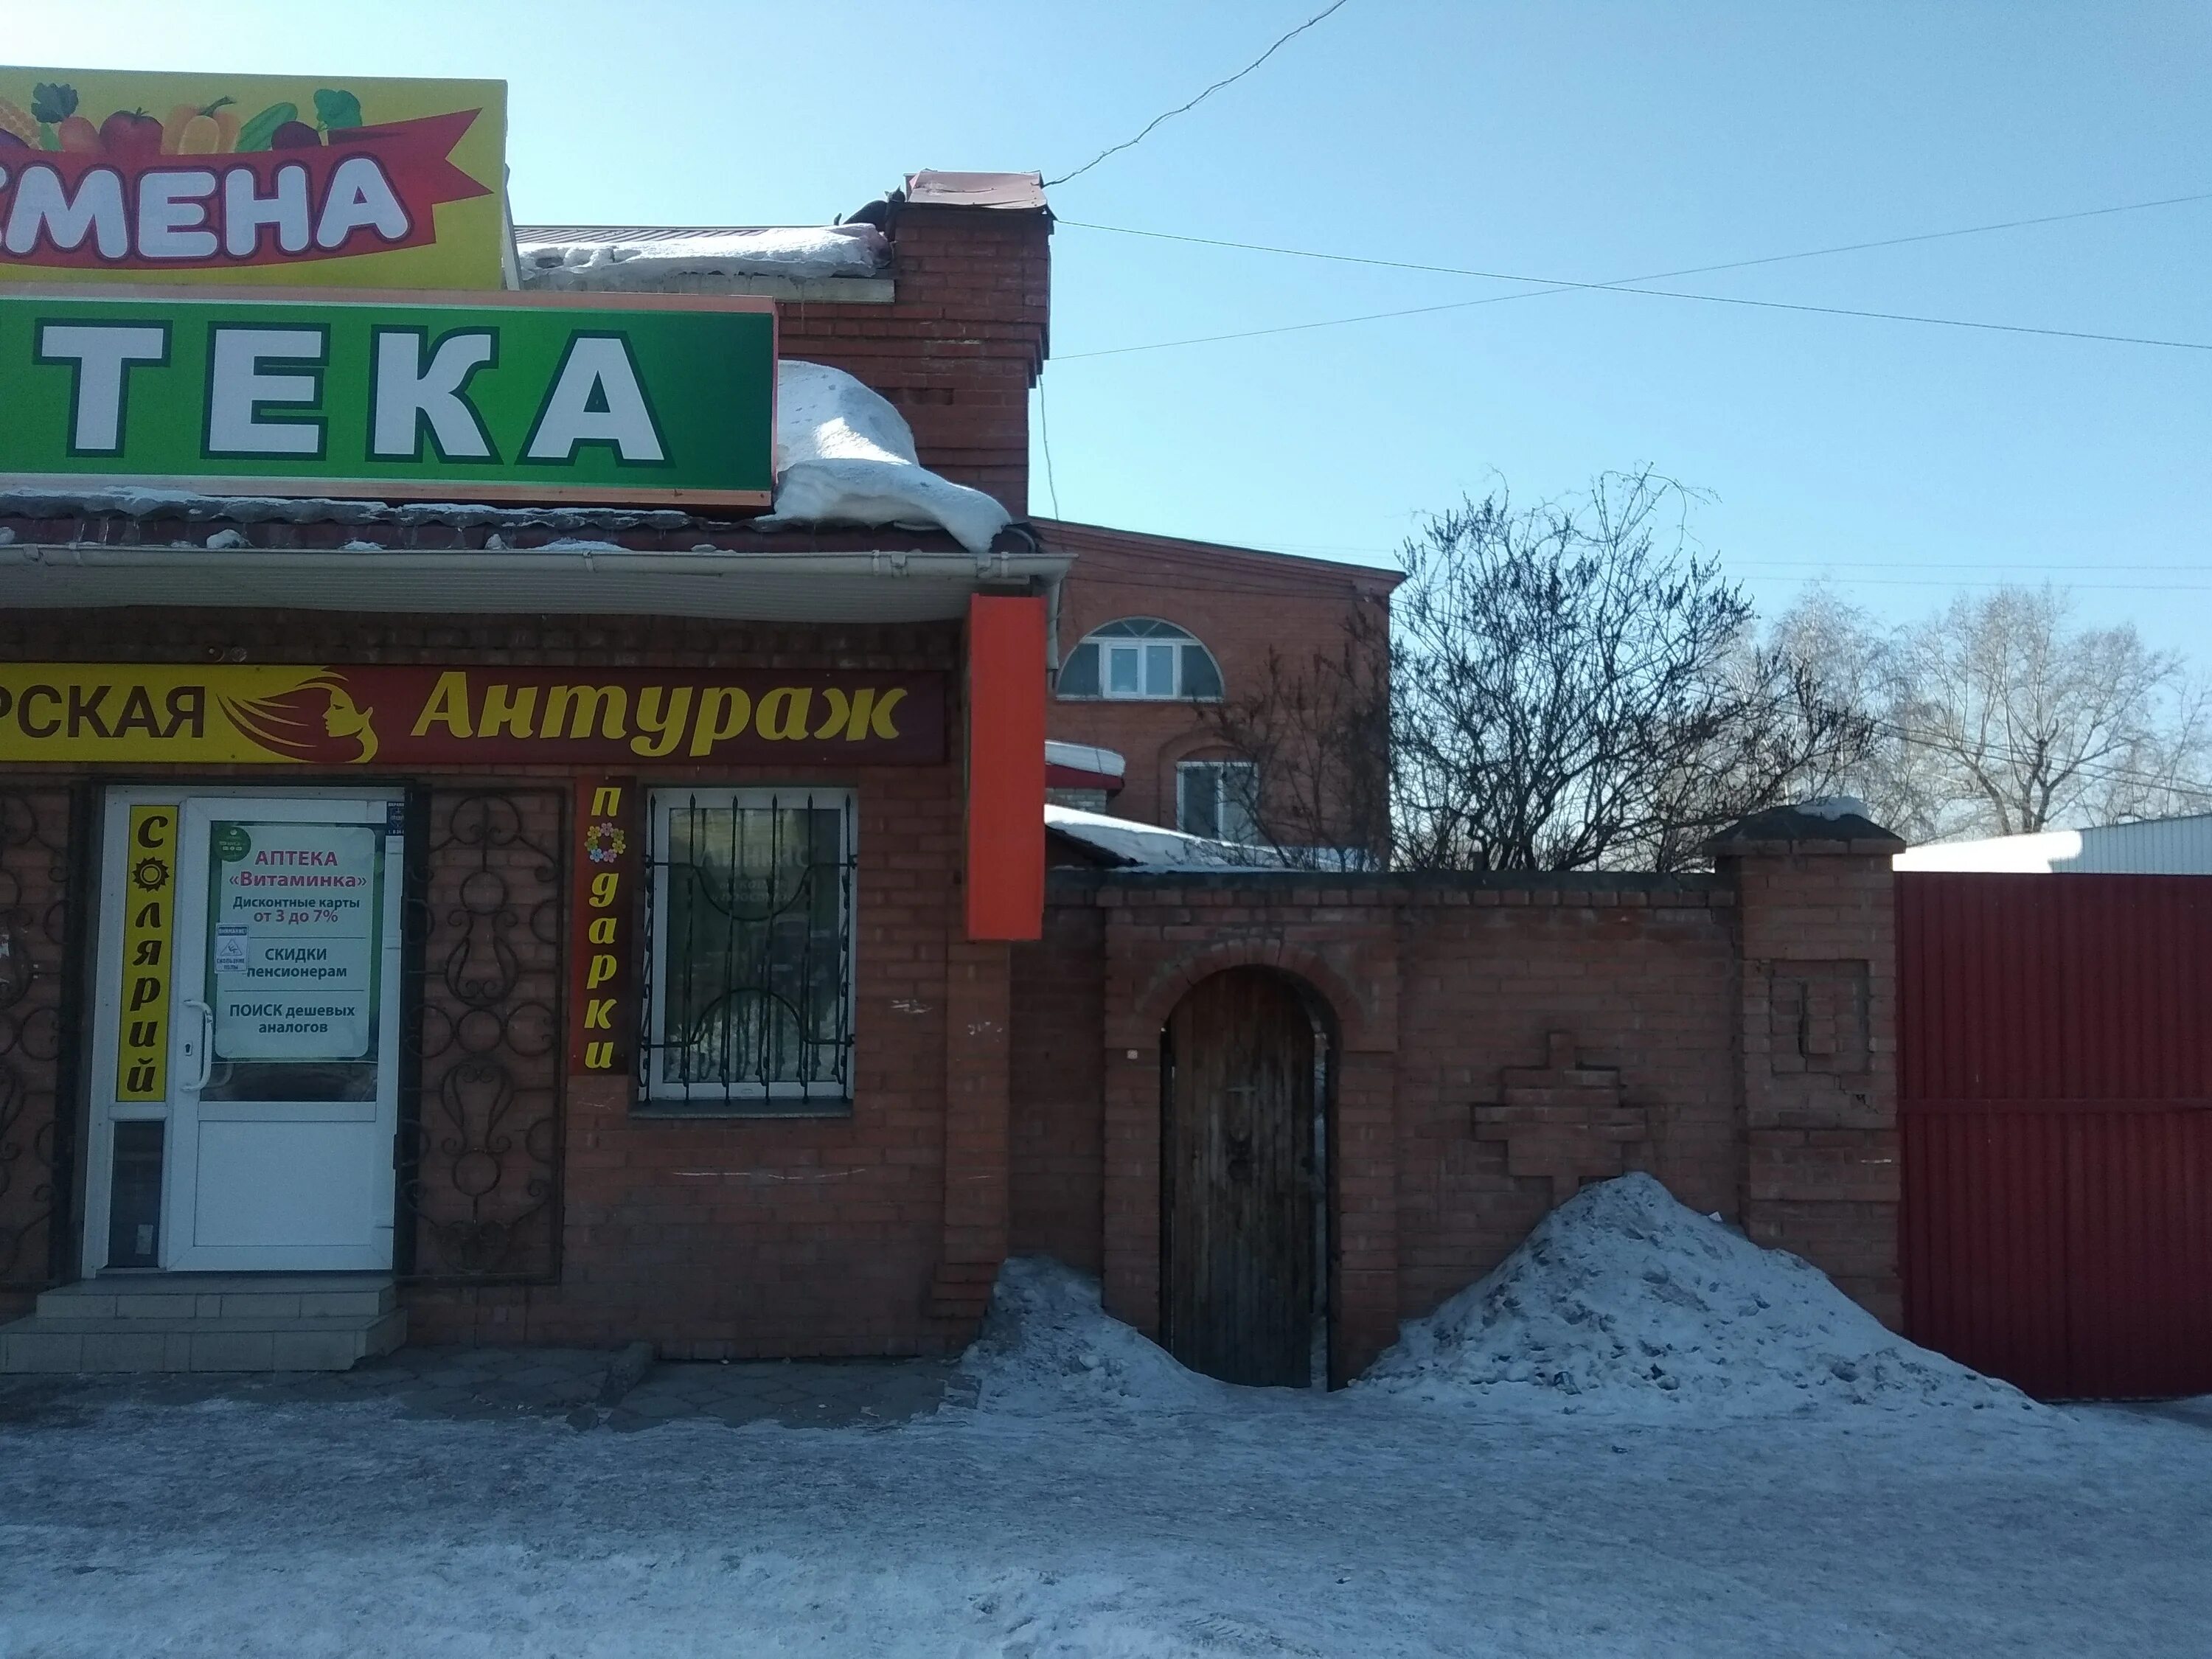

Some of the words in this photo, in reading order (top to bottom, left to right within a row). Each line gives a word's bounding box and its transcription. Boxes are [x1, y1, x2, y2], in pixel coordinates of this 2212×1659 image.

[0, 157, 411, 260] МЕНА
[35, 319, 671, 466] ТЕКА
[411, 671, 908, 757] Антураж
[254, 850, 338, 866] АПТЕКА
[229, 871, 367, 888] «Витаминка»
[232, 896, 316, 910] Дисконтные
[319, 899, 360, 911] карты
[254, 912, 271, 922] от
[276, 910, 285, 922] 3
[288, 912, 309, 925] до
[313, 910, 338, 922] 7%
[265, 948, 327, 963] СКИДКИ
[247, 967, 347, 980] пенсионерам
[230, 1004, 282, 1017] ПОИСК
[285, 1007, 355, 1018] дешевых
[259, 1023, 327, 1033] аналогов
